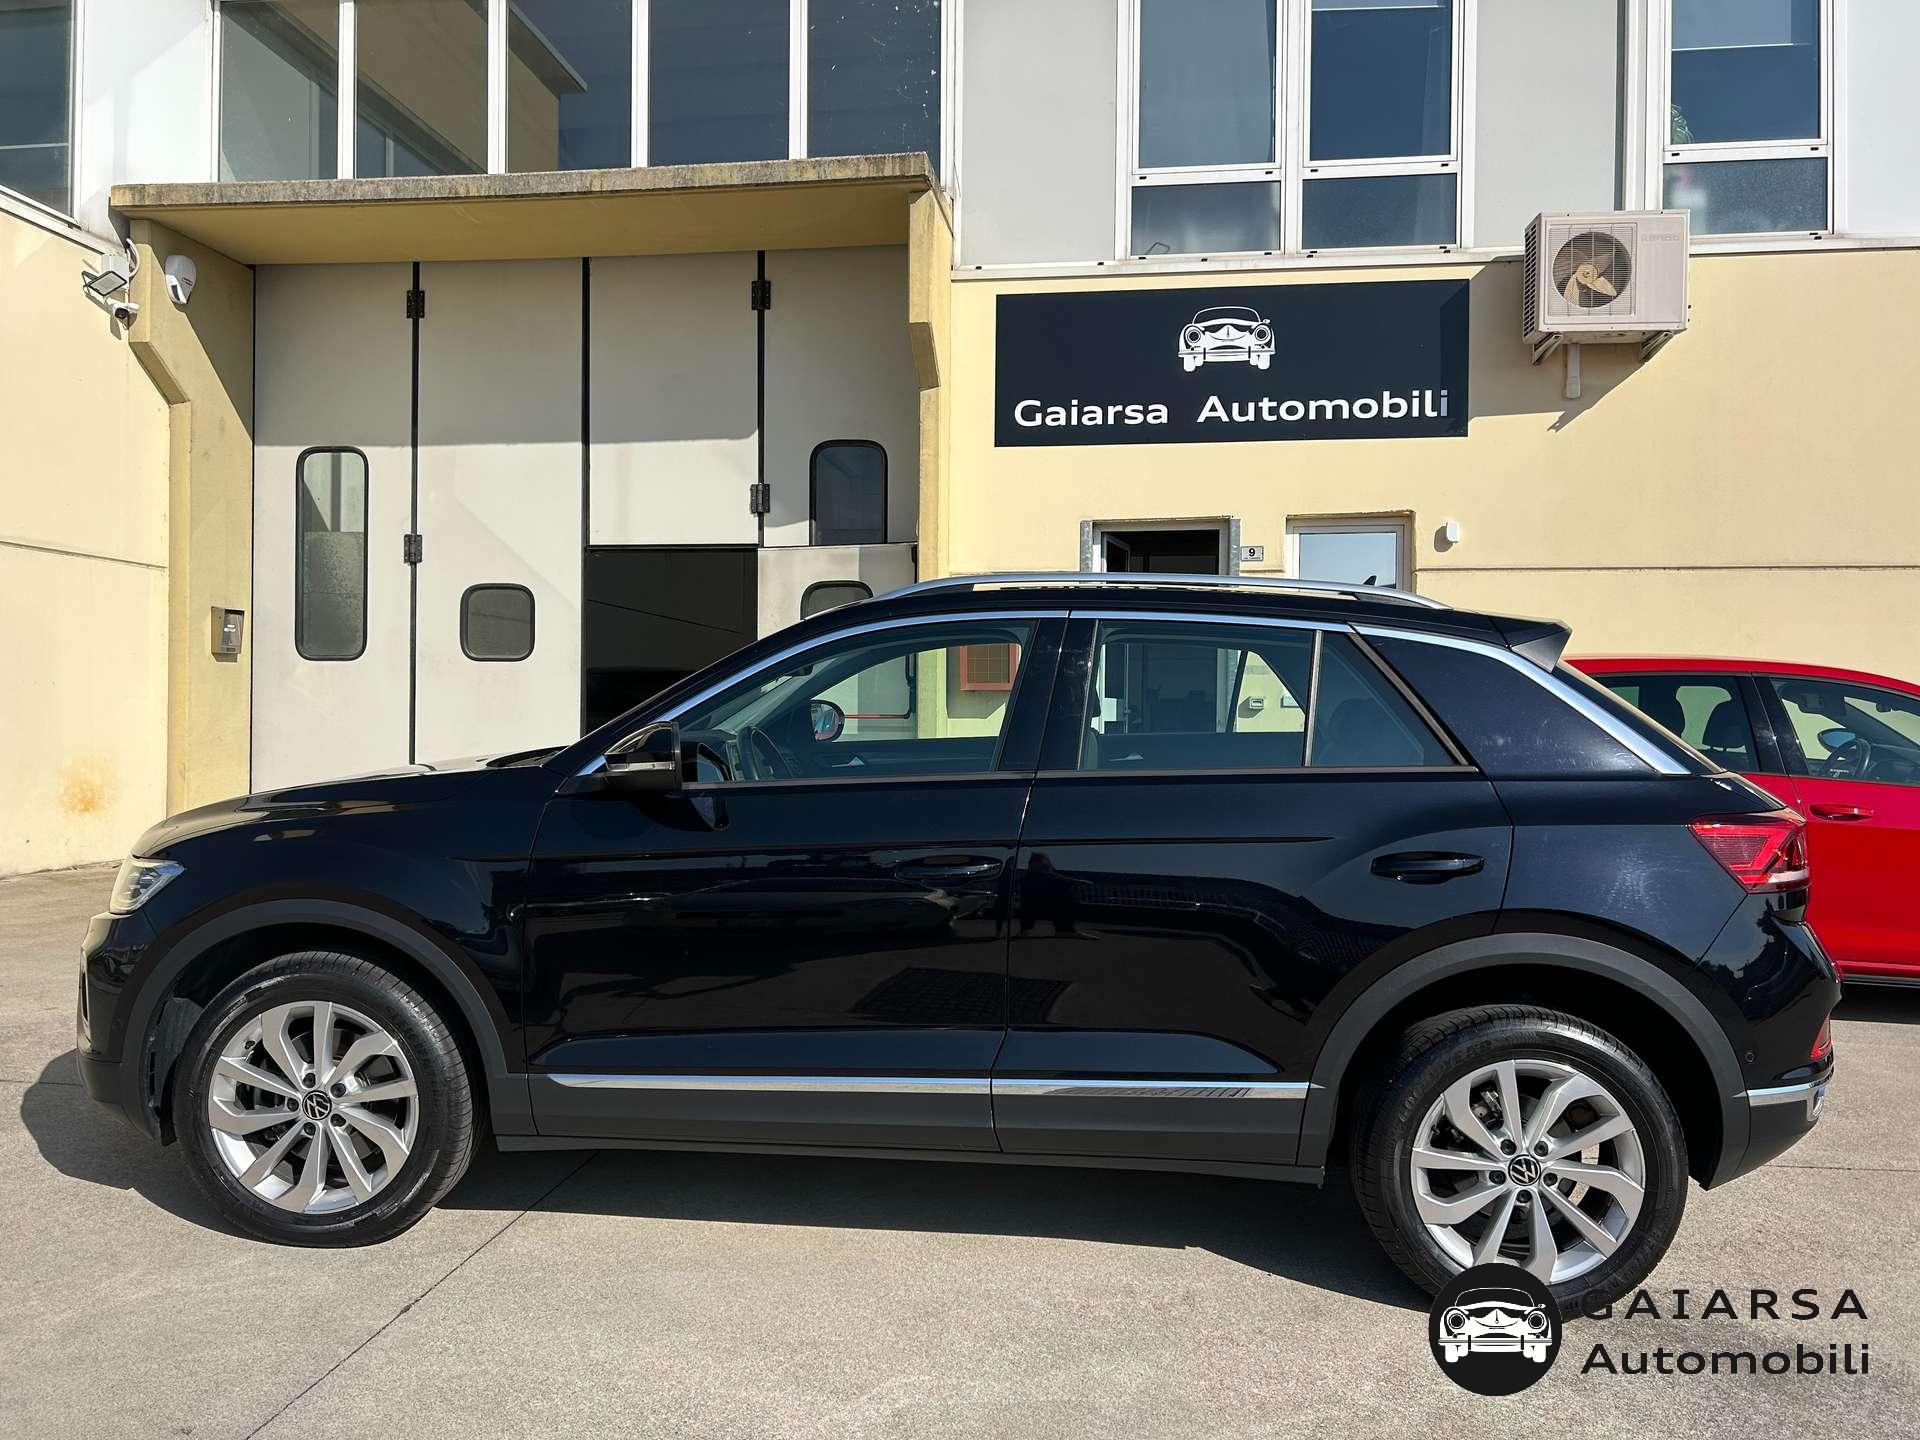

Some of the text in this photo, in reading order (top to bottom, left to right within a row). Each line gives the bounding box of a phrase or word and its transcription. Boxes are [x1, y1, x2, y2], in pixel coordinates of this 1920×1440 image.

[1013, 389, 1448, 427] Gaiarsa Automobili
[1248, 547, 1256, 557] 9
